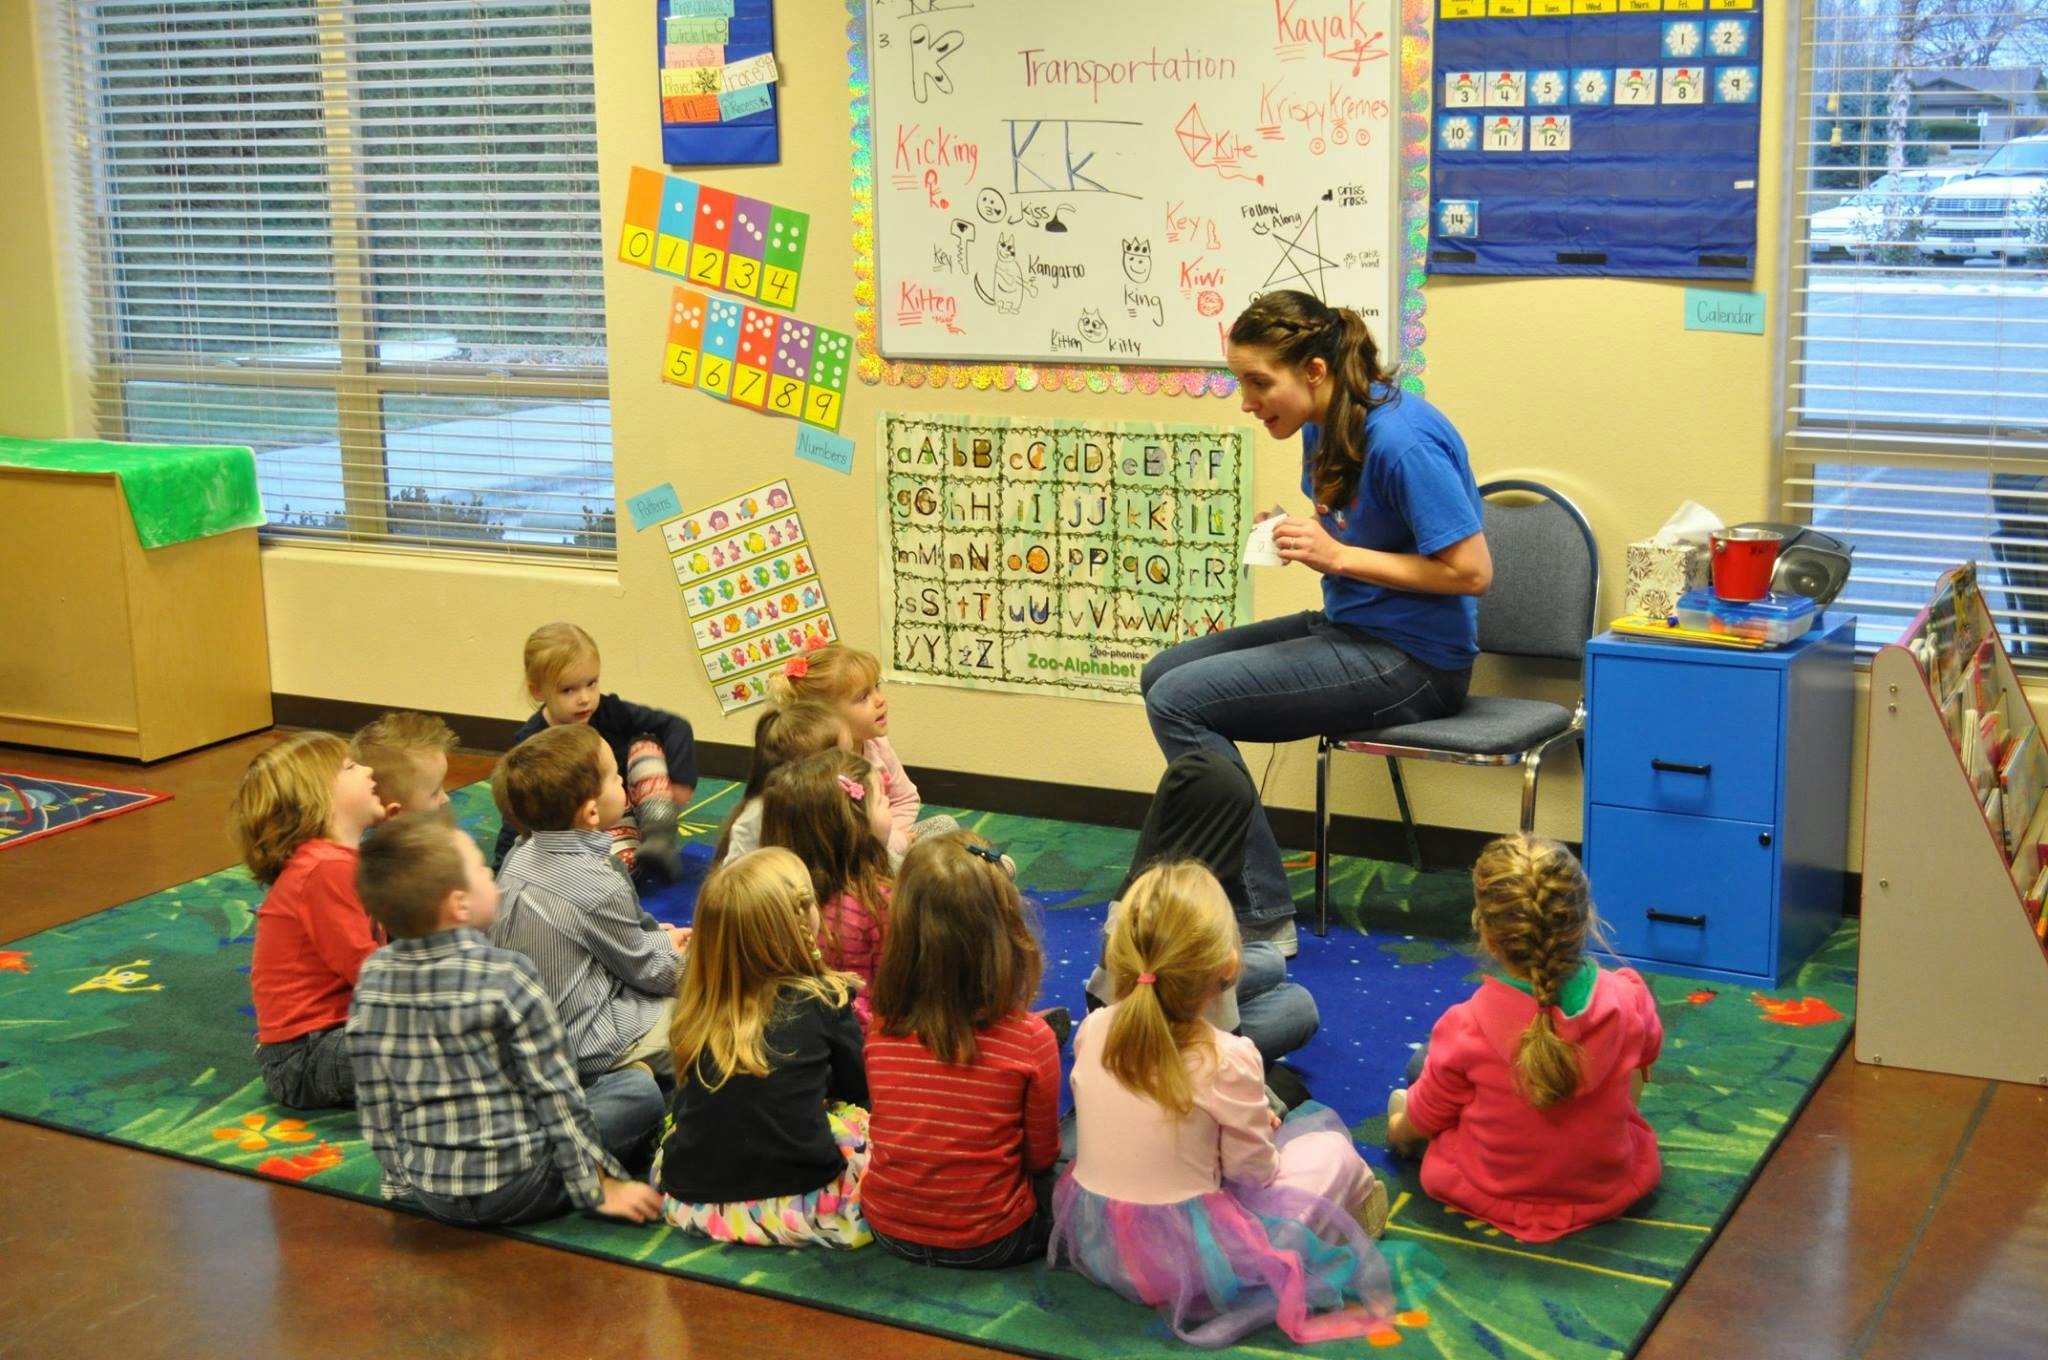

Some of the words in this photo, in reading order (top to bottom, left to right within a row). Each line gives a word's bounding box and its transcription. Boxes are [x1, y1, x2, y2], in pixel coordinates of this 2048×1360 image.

[1680, 33, 1685, 45] 1
[1723, 32, 1732, 44] 2
[1018, 47, 1235, 103] Transportation
[1460, 91, 1469, 103] 3
[1500, 91, 1509, 102] 4
[1544, 82, 1552, 94] 5
[1586, 81, 1595, 93] 6
[1631, 88, 1640, 100] 7
[1678, 87, 1687, 99] 8
[1731, 79, 1740, 91] 9
[1214, 130, 1258, 160] Kite
[1451, 128, 1464, 139] 10
[1498, 135, 1508, 146] 11
[1544, 135, 1557, 146] 12
[1166, 200, 1200, 241] Key
[1241, 203, 1280, 219] Follow
[1451, 213, 1464, 225] 14
[628, 232, 649, 258] 0
[667, 242, 679, 267] 1
[698, 252, 718, 279] 2
[734, 263, 755, 289] 3
[771, 271, 789, 299] 4
[1028, 254, 1085, 288] Kangaroo
[1180, 256, 1226, 289] Kiwi
[901, 281, 957, 313] Kitten
[1696, 300, 1757, 325] Calendar
[671, 351, 692, 377] 5
[706, 363, 723, 387] 6
[740, 371, 762, 396] 7
[776, 382, 798, 408] 8
[816, 393, 833, 420] 9
[798, 432, 848, 465] Numbers
[1027, 653, 1136, 678] Zoo-Alphabet
